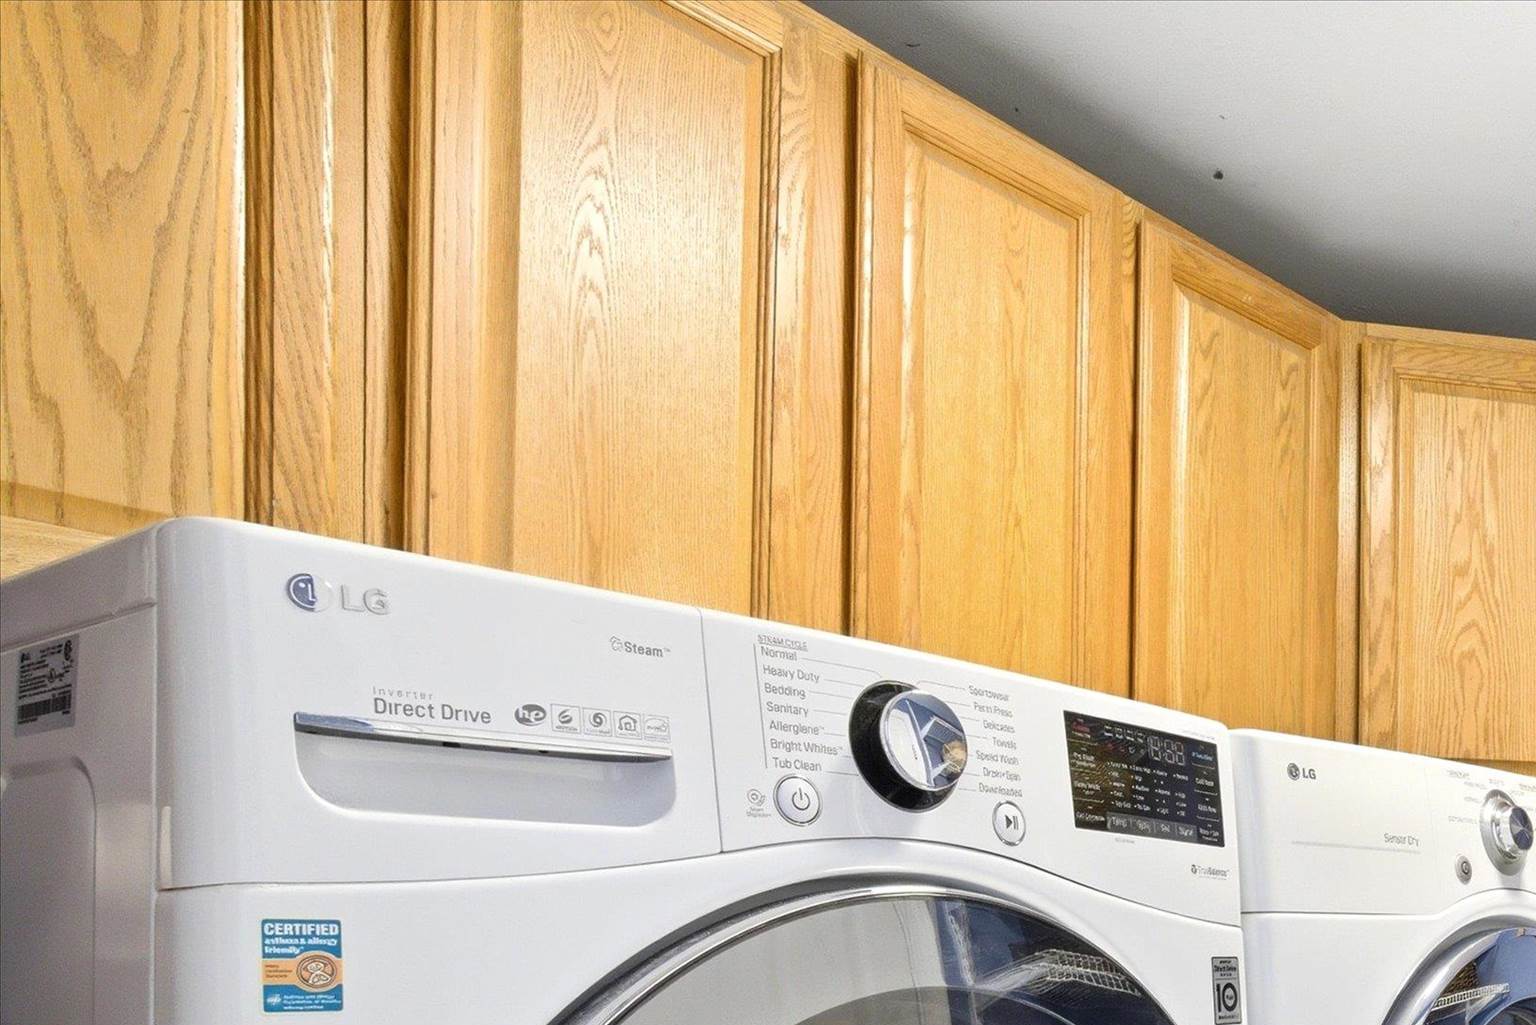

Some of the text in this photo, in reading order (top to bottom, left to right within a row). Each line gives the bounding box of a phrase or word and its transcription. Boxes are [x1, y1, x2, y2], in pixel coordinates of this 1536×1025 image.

[340, 584, 391, 615] LG
[761, 646, 798, 661] Normal
[763, 664, 820, 683] Heavy Duty
[764, 682, 806, 700] Bedding
[374, 697, 492, 724] Direct Drive
[766, 701, 809, 718] Sanitary
[770, 738, 801, 753] Bright
[772, 757, 822, 772] Tub Clean
[1302, 768, 1317, 780] LG
[264, 923, 339, 936] CERTIFIED
[1216, 983, 1238, 1013] 10
